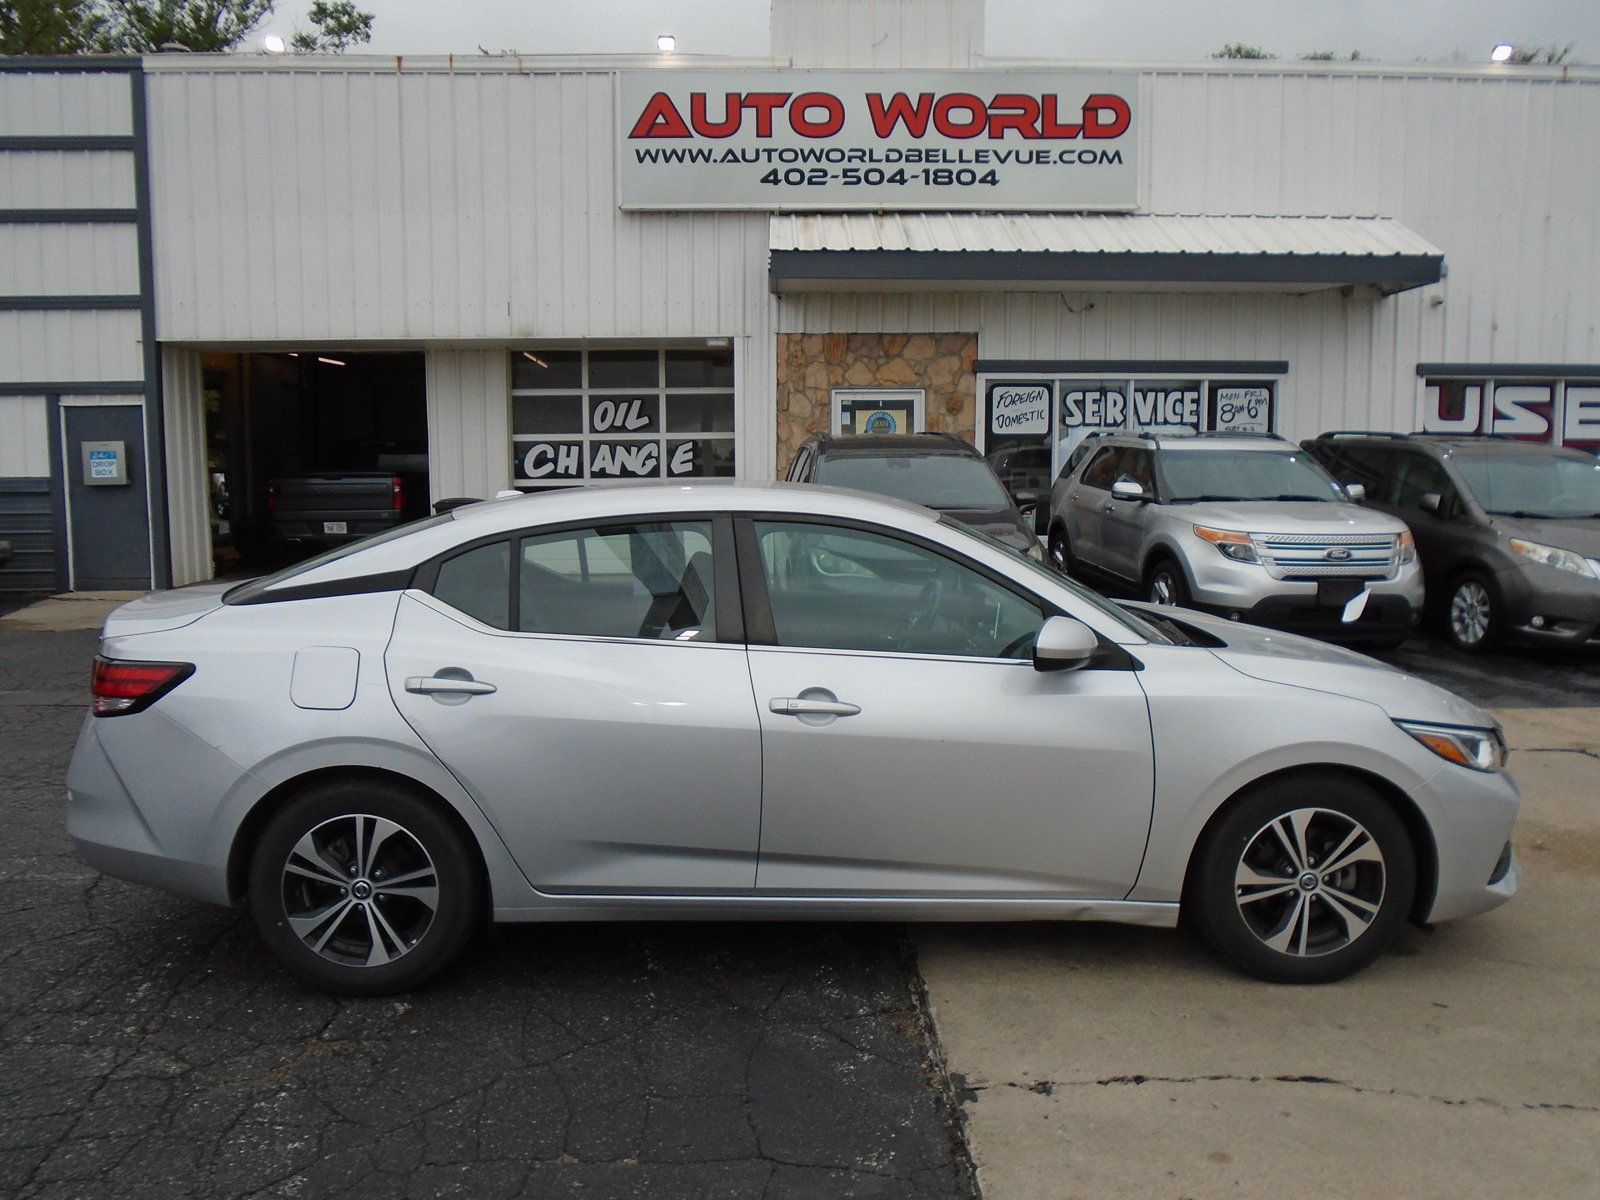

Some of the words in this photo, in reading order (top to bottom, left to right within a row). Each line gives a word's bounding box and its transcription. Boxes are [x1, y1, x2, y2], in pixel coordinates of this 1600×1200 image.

[628, 91, 845, 139] AUTO
[865, 91, 1132, 140] WORLD
[635, 147, 1124, 165] WWW.AUTOWORLDBELLEVUE.COM
[759, 167, 1001, 186] 402-504-1804
[997, 389, 1045, 409] FOREIGN
[1063, 390, 1199, 427] SERVICE
[593, 399, 650, 432] OIL
[996, 409, 1046, 429] DOMESTIC
[523, 441, 694, 478] CHANGE
[1330, 550, 1349, 559] Ford
